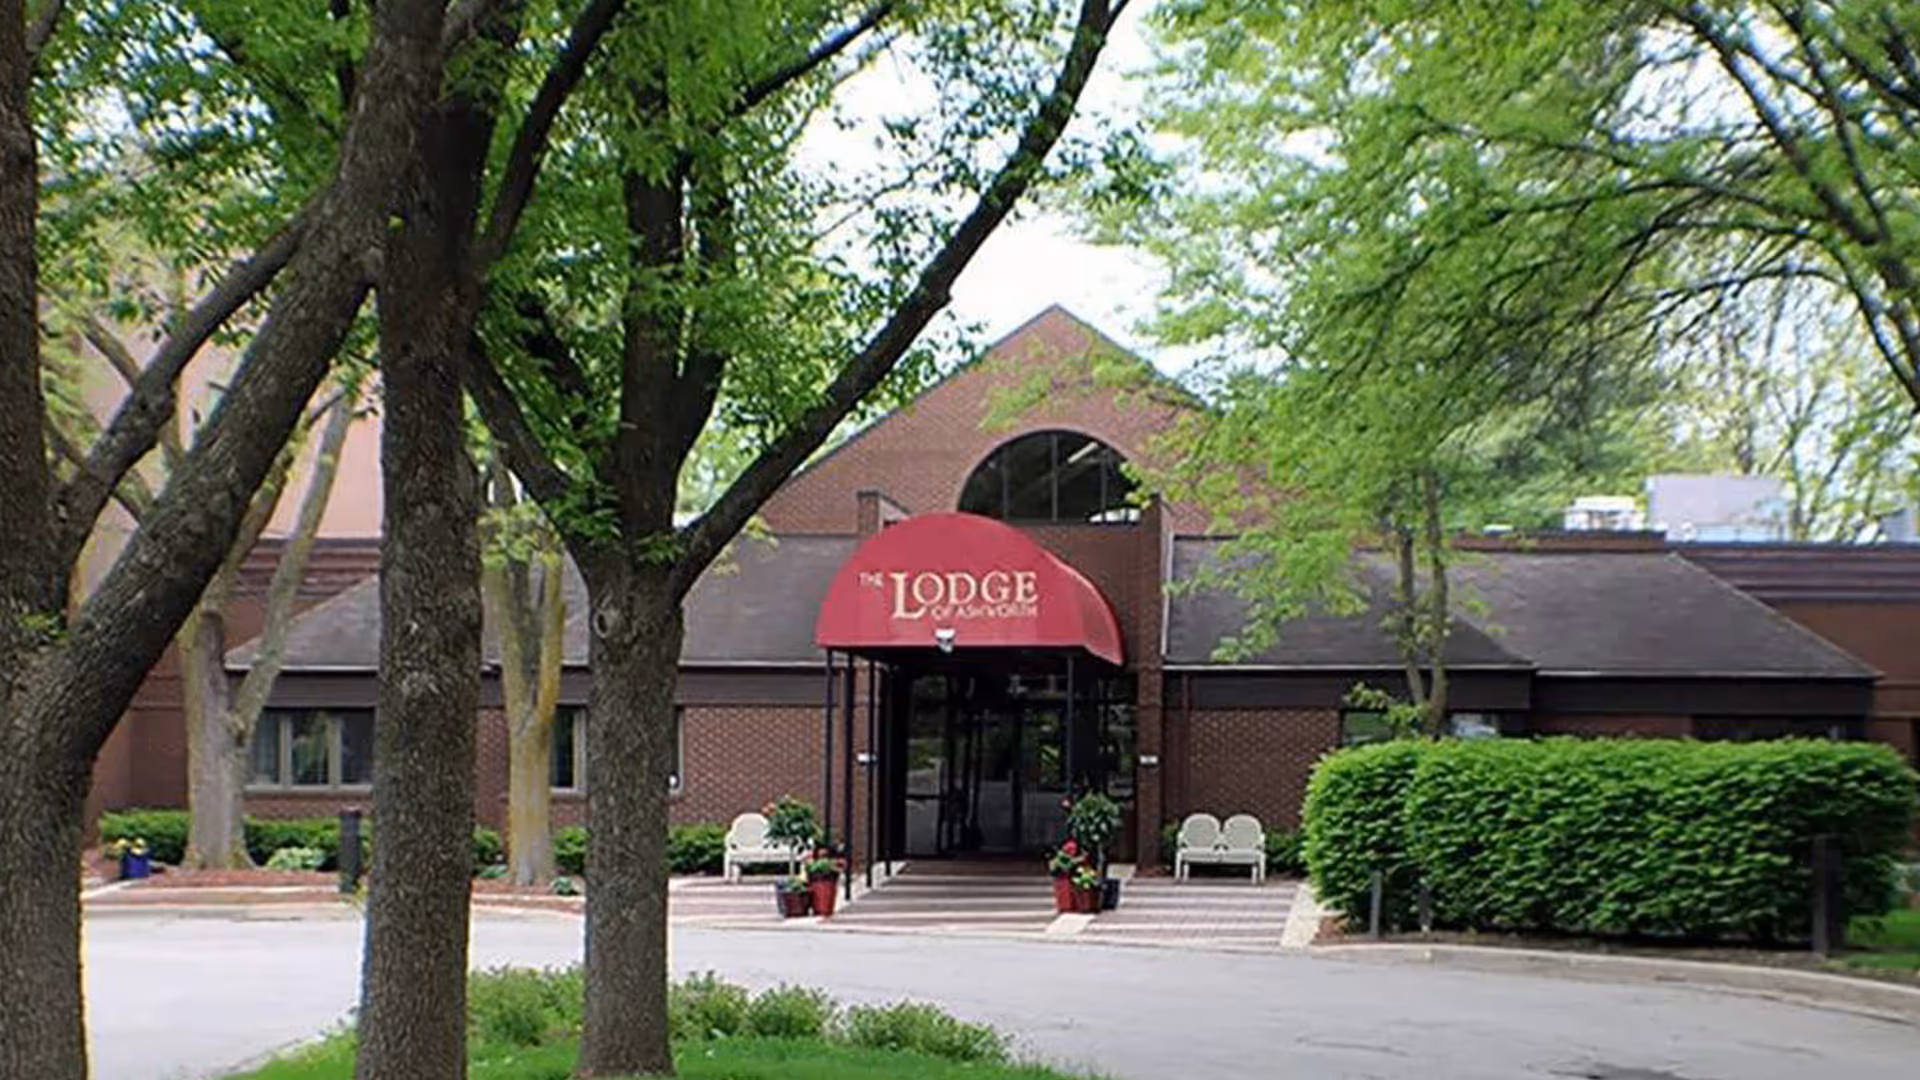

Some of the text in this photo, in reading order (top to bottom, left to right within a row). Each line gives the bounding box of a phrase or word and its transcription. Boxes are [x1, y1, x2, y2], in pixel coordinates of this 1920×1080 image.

[859, 571, 1038, 619] THE LODGE
[930, 605, 952, 620] OF
